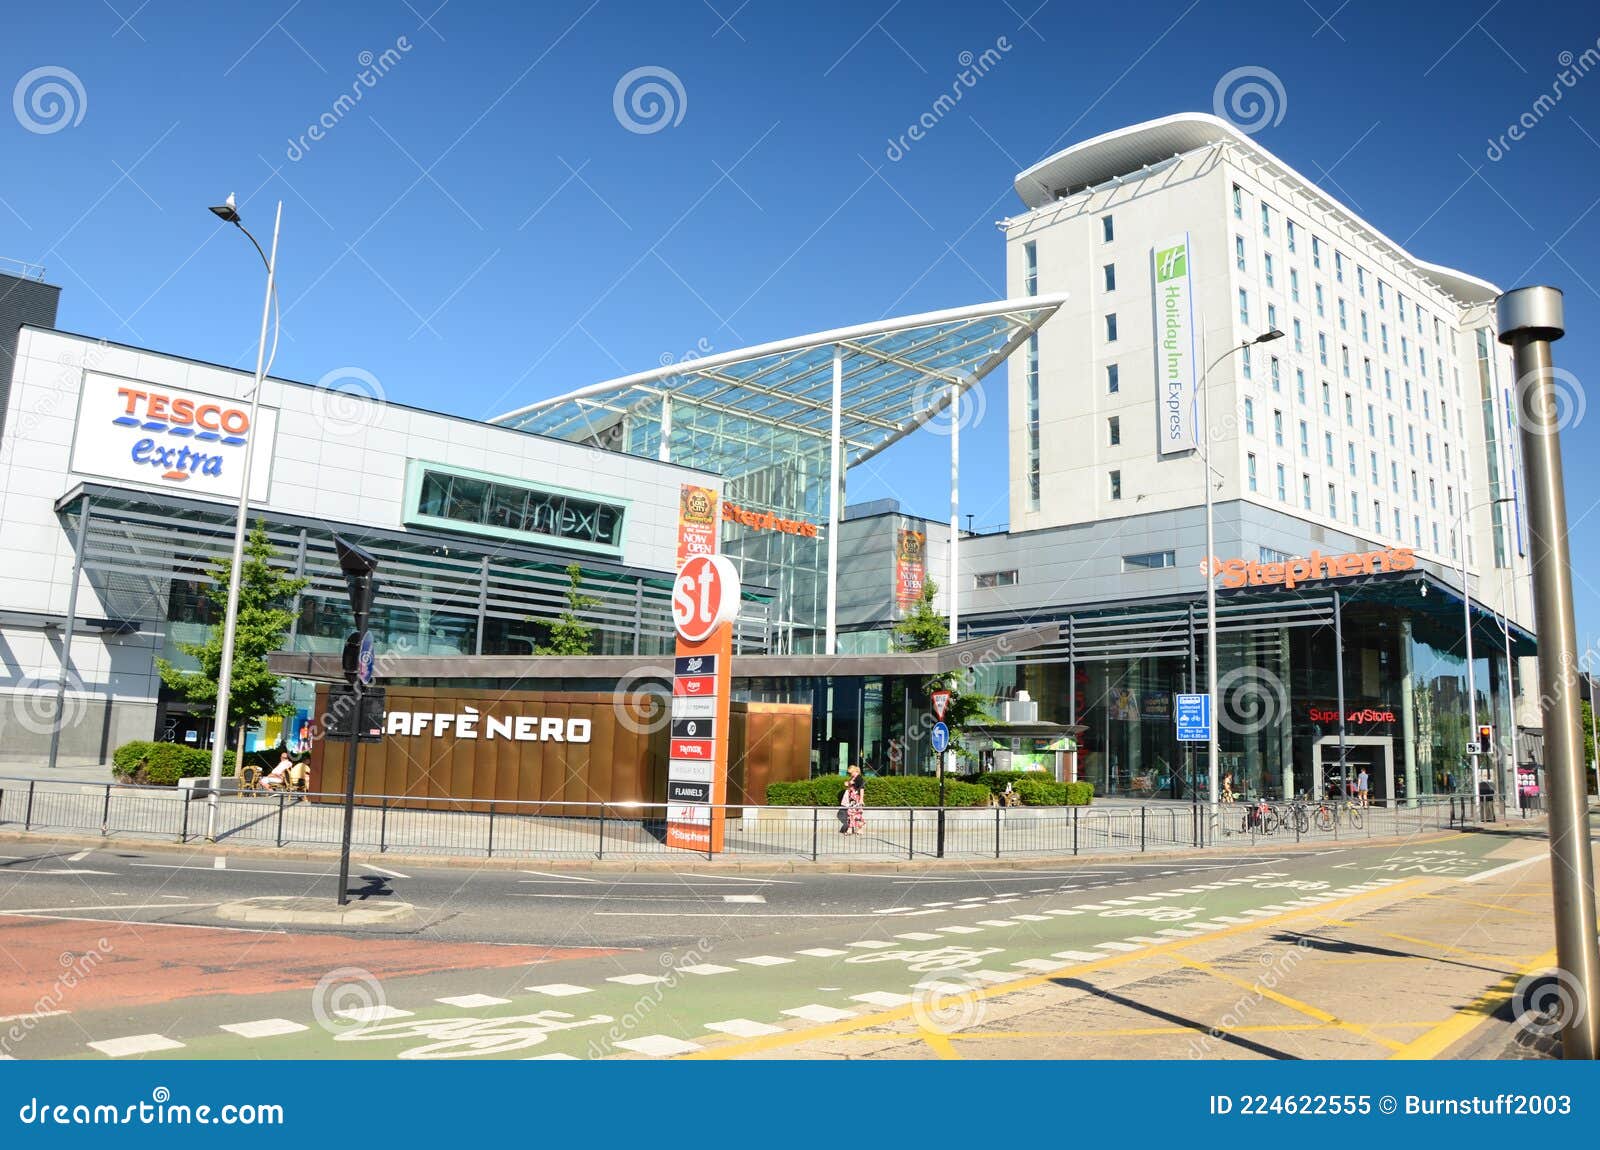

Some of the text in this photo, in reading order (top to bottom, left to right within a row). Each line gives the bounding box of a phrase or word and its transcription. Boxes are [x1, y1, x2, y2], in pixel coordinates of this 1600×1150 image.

[1163, 285, 1183, 440] Holiday Inn Express
[118, 387, 250, 434] TESCO
[132, 438, 224, 477] extra
[533, 503, 610, 538] next
[683, 532, 707, 543] NOW
[687, 543, 713, 553] OPEN
[674, 560, 714, 625] st
[382, 706, 591, 743] AFFÈ NERO
[675, 788, 703, 797] FLANNELS
